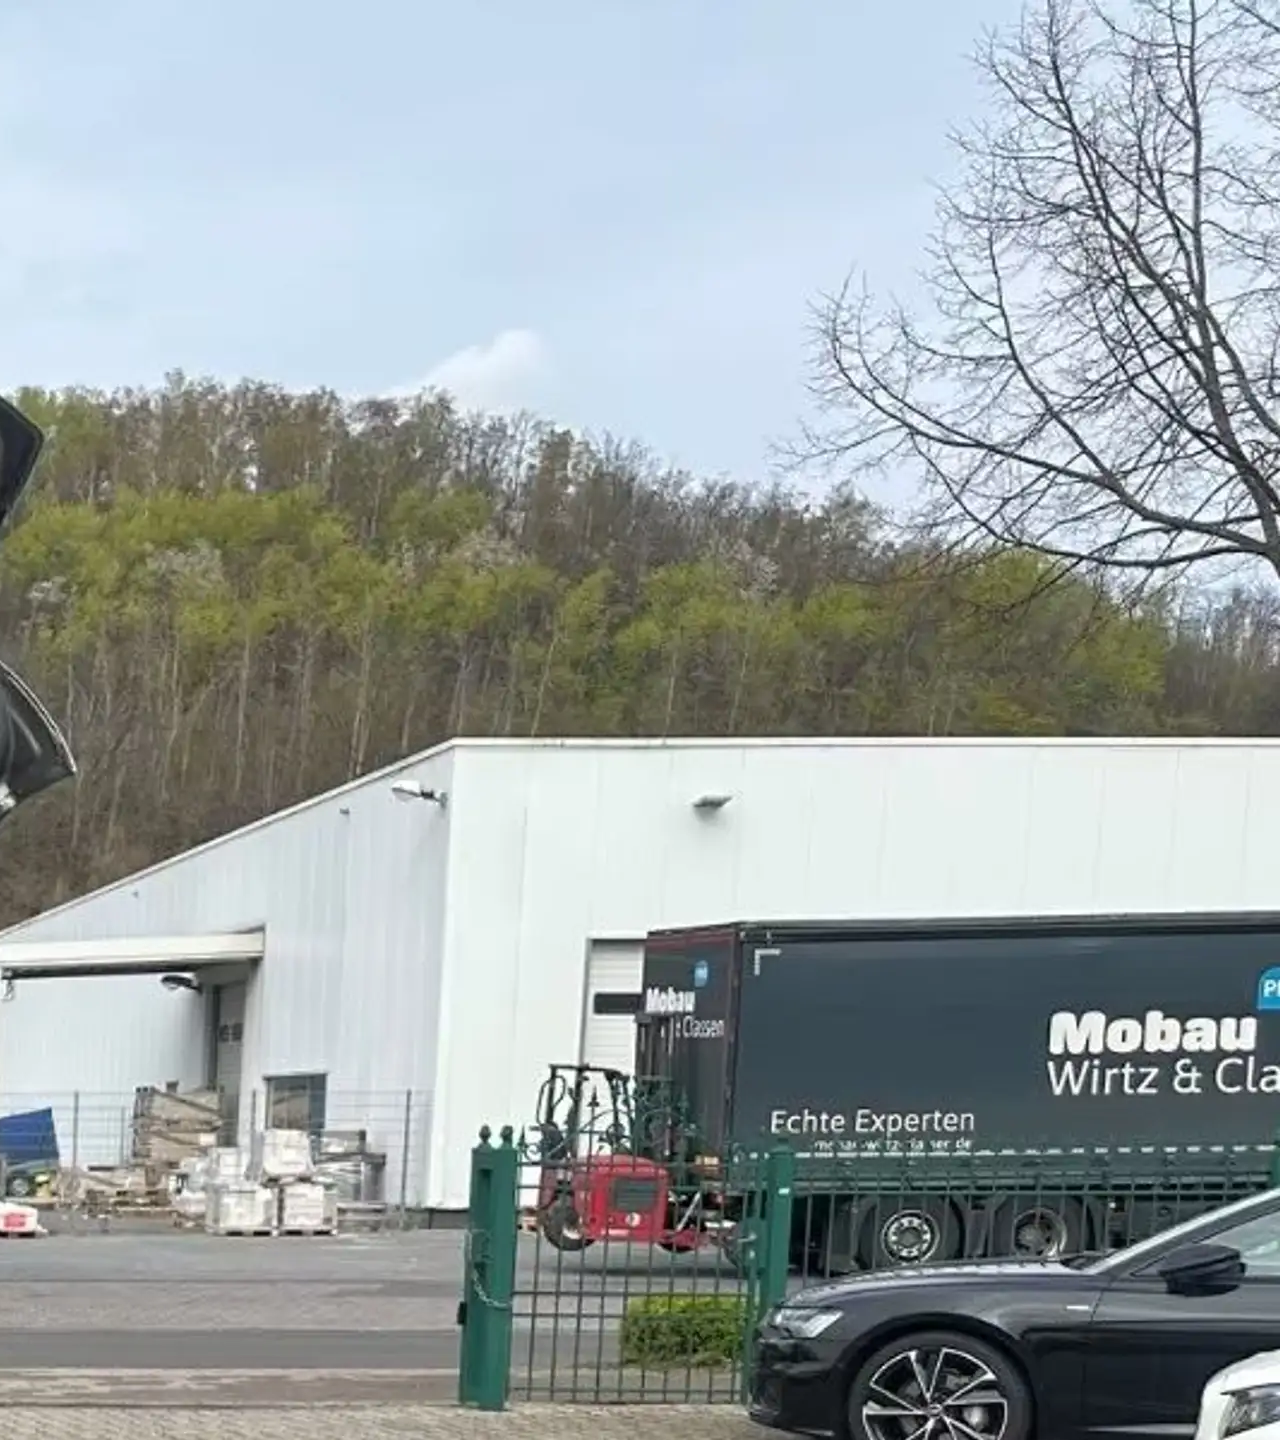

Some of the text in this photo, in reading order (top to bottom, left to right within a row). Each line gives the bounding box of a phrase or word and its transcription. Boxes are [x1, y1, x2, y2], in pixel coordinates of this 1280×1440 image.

[645, 986, 695, 1014] Mobau
[1048, 1010, 1258, 1055] Mobau
[1047, 1058, 1159, 1096] Wirtz
[1172, 1057, 1203, 1095] &
[770, 1108, 975, 1137] Echte Experten
